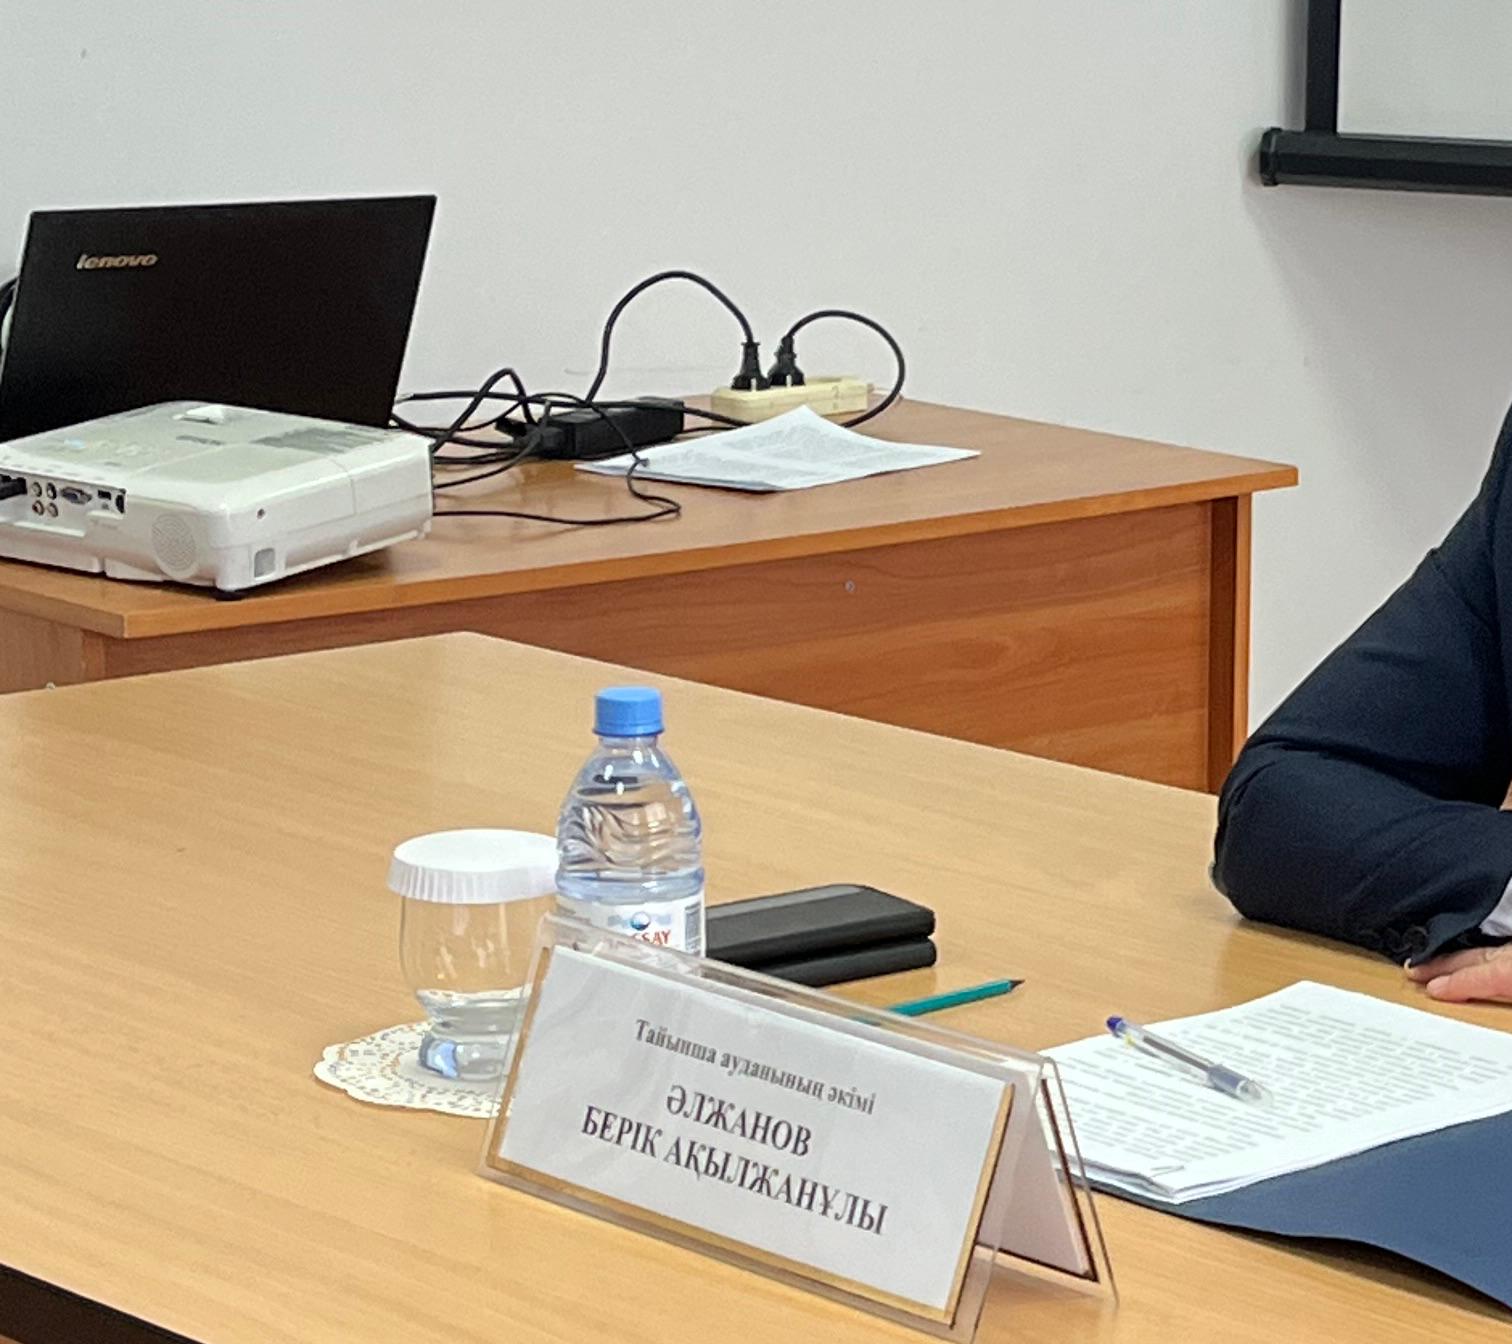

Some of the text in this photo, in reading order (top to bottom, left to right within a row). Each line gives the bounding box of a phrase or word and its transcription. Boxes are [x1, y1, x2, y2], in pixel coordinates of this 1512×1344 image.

[76, 254, 158, 269] lenovo
[635, 1018, 877, 1115] Тайынша ауданының әкімі
[666, 1084, 813, 1157] ӘЛЖАНОВ
[581, 1105, 889, 1236] БЕРІК АҚЫЛЖАНҰЛЫ
